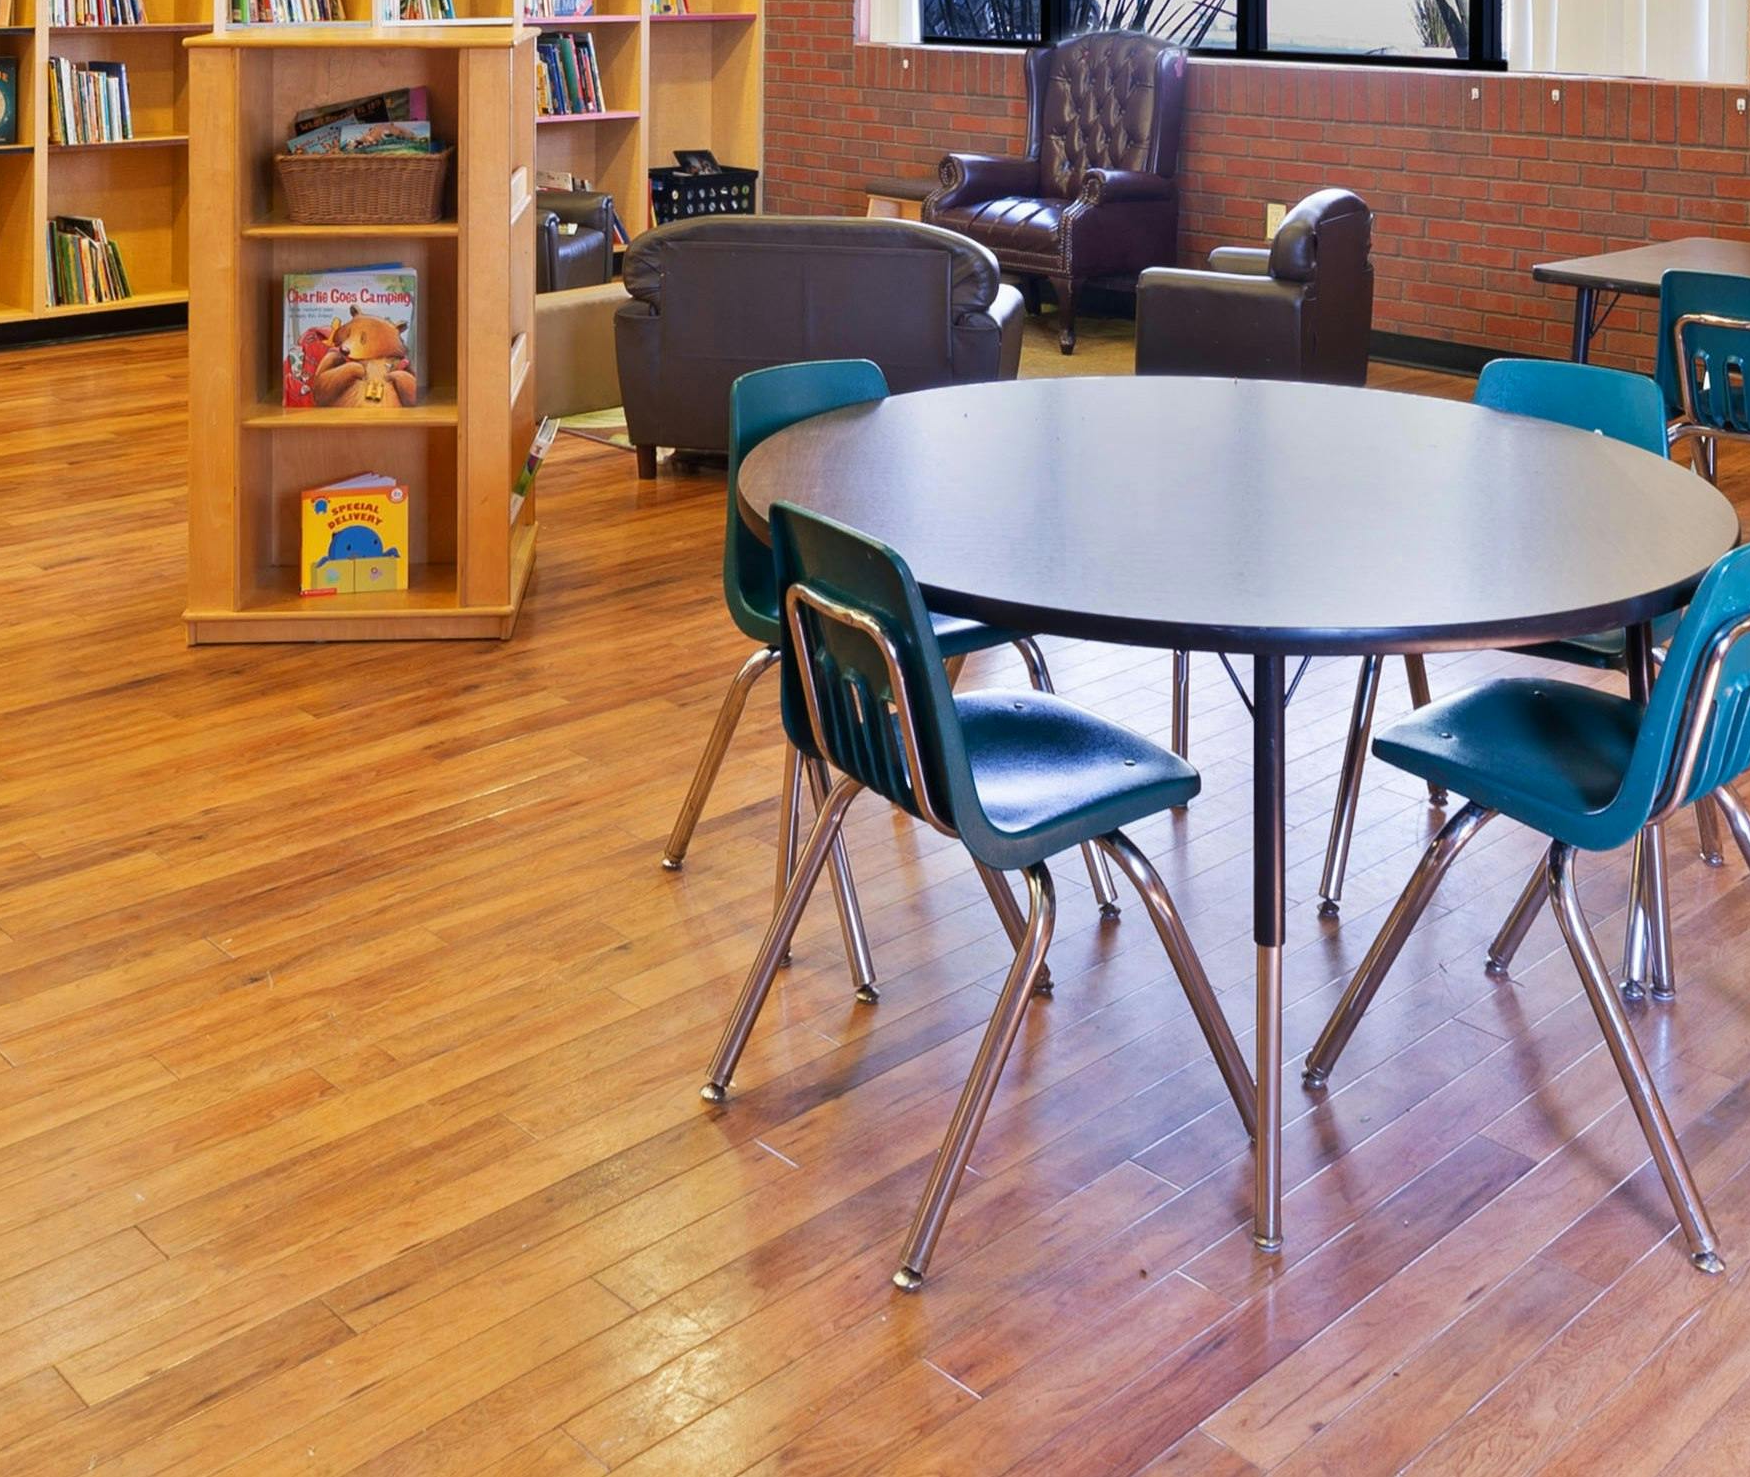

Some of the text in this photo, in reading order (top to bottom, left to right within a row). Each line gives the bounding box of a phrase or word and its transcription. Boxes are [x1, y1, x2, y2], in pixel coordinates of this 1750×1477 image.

[286, 287, 411, 306] Charlie Goes Camping
[330, 502, 379, 516] SPECIAL
[327, 512, 383, 530] DELIVERY
